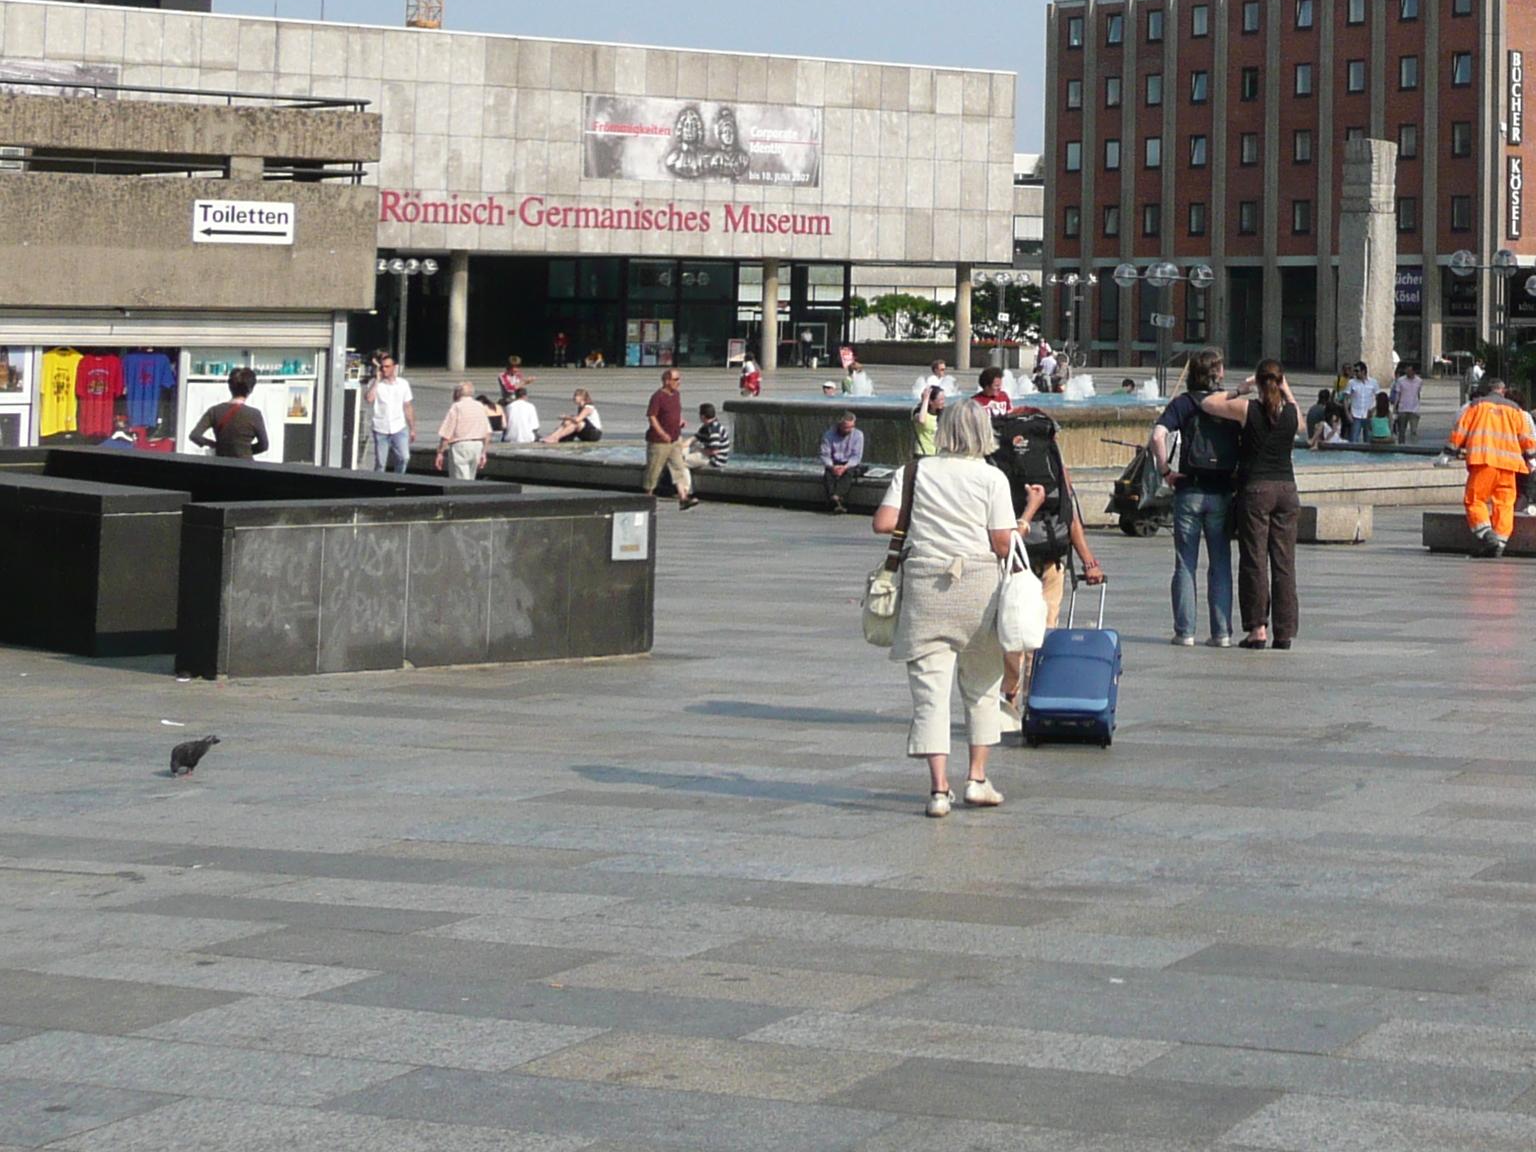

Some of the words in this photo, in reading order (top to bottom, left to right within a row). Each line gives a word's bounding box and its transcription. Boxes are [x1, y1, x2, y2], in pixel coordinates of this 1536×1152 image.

[1511, 52, 1522, 142] BÜCHER
[750, 127, 798, 141] Corporate
[750, 141, 786, 157] Identity
[1510, 159, 1522, 236] KÖSEL
[199, 204, 289, 225] Toiletten
[379, 190, 711, 232] Römisch-Germanisches
[723, 203, 832, 236] Museum
[1395, 272, 1422, 285] ücher
